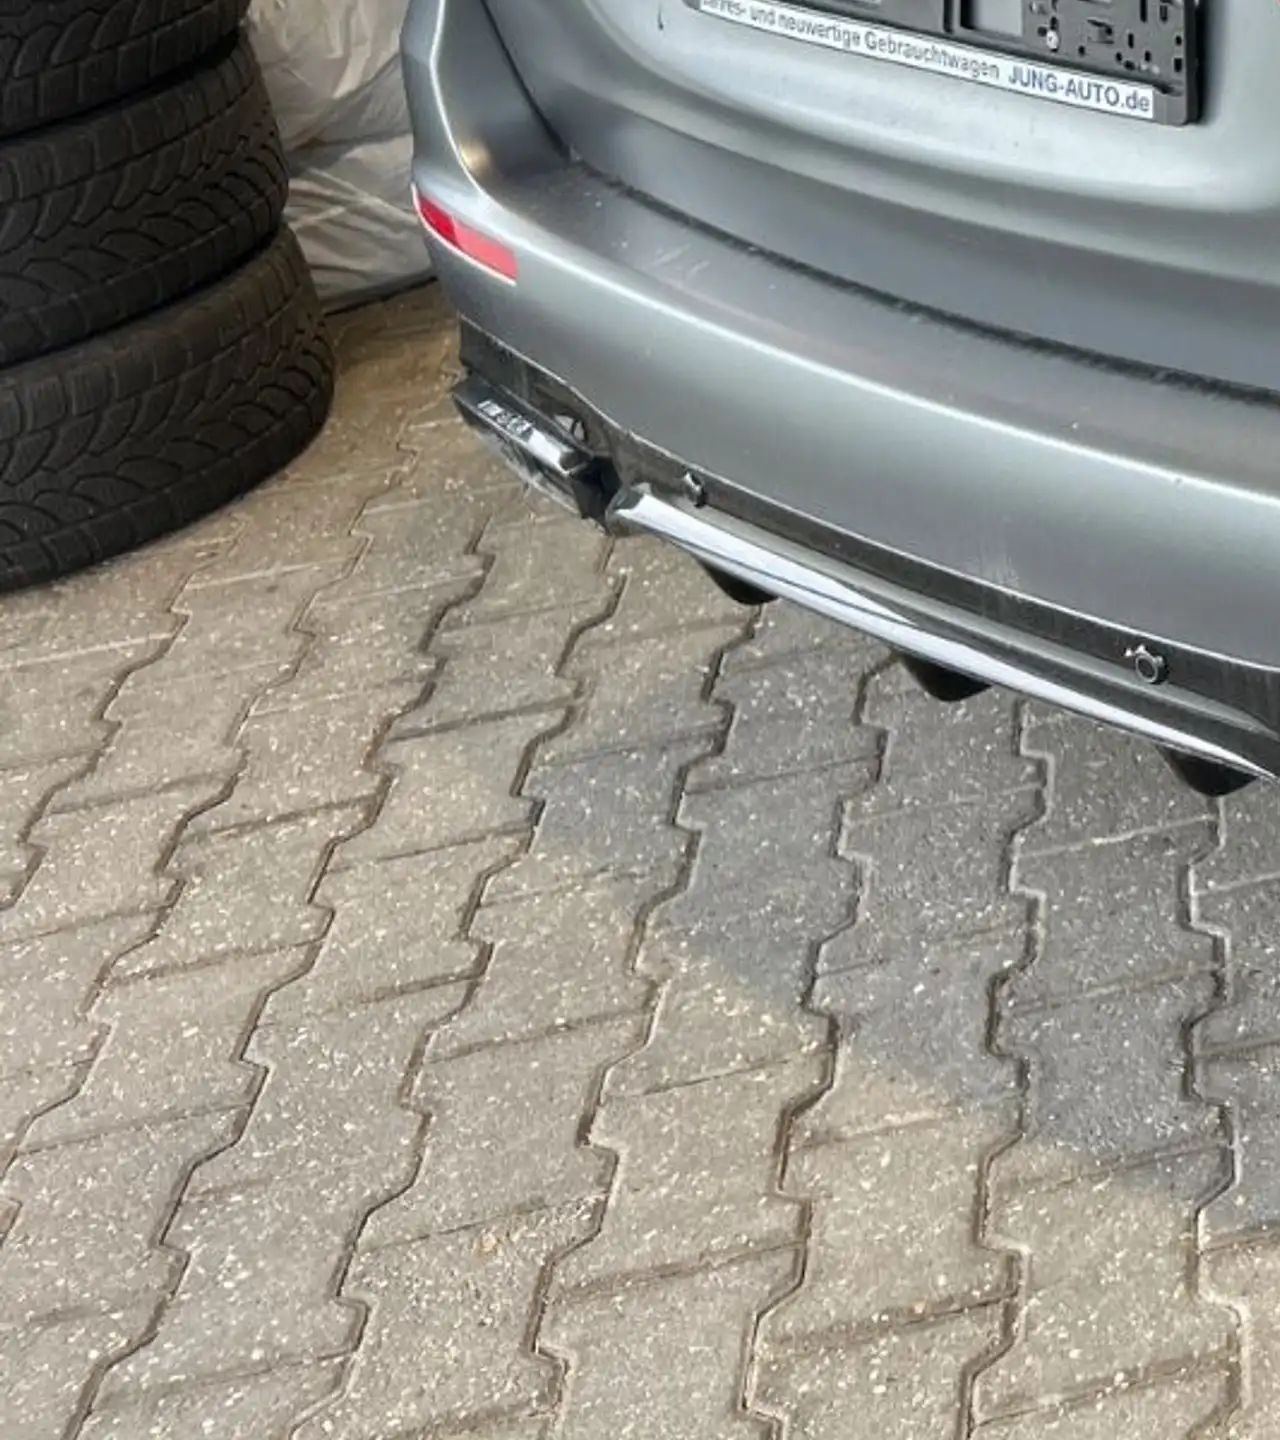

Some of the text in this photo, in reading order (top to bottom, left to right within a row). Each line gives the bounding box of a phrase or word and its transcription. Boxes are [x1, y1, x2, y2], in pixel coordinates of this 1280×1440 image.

[750, 3, 777, 27] und
[778, 13, 861, 48] neuwertige
[864, 30, 1000, 79] Gebrauchtwagen
[1008, 65, 1151, 112] JUNG-AUTO.de
